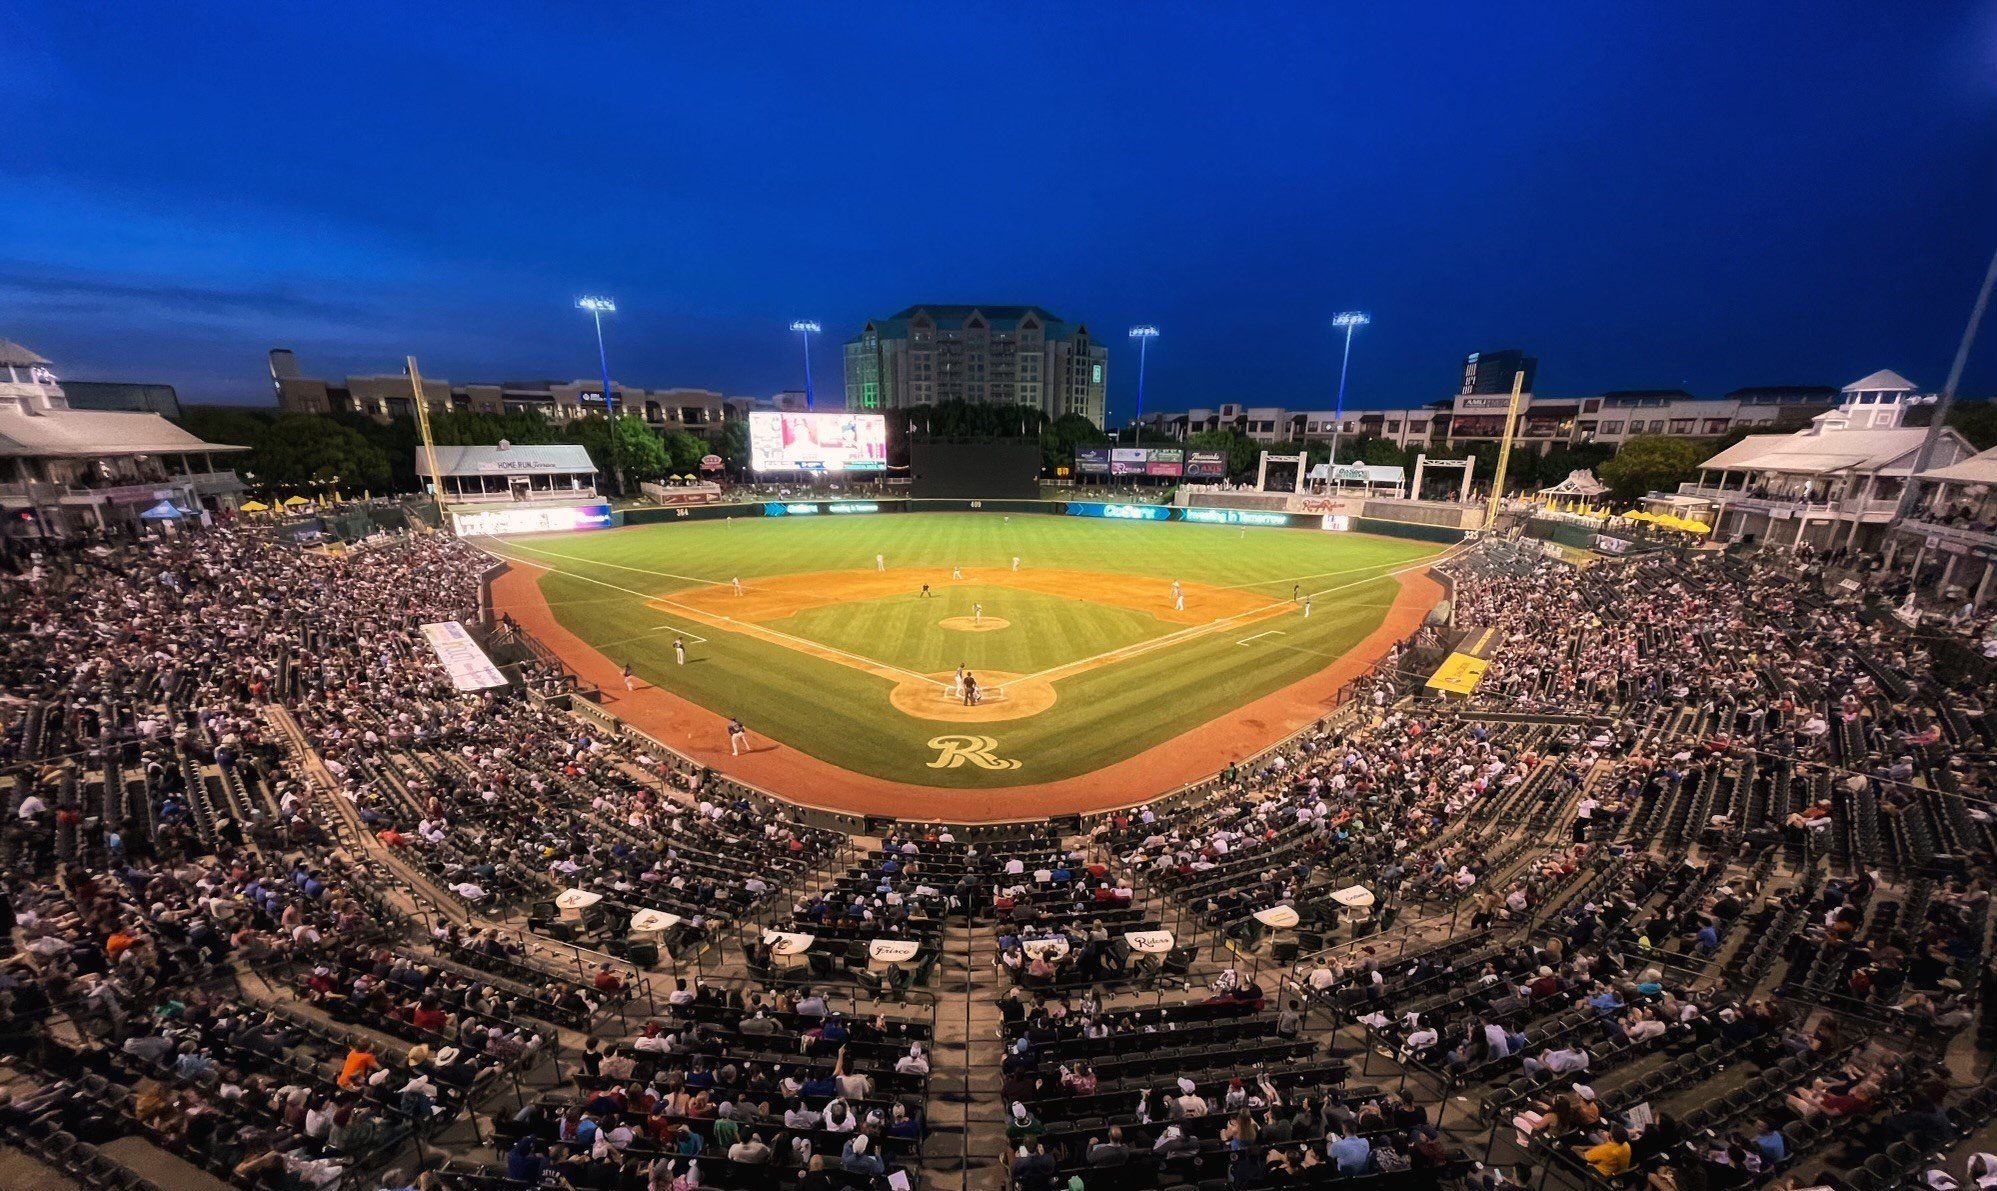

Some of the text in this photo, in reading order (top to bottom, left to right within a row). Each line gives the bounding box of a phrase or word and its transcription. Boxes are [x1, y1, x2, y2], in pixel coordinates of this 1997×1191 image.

[498, 461, 517, 469] HOME
[518, 461, 532, 469] RUN
[676, 508, 688, 516] 364
[1187, 508, 1226, 523] Investing
[1238, 511, 1287, 525] Tomorrow
[1464, 530, 1479, 540] 335
[1134, 936, 1169, 948] Riders
[875, 945, 910, 955] Frisco
